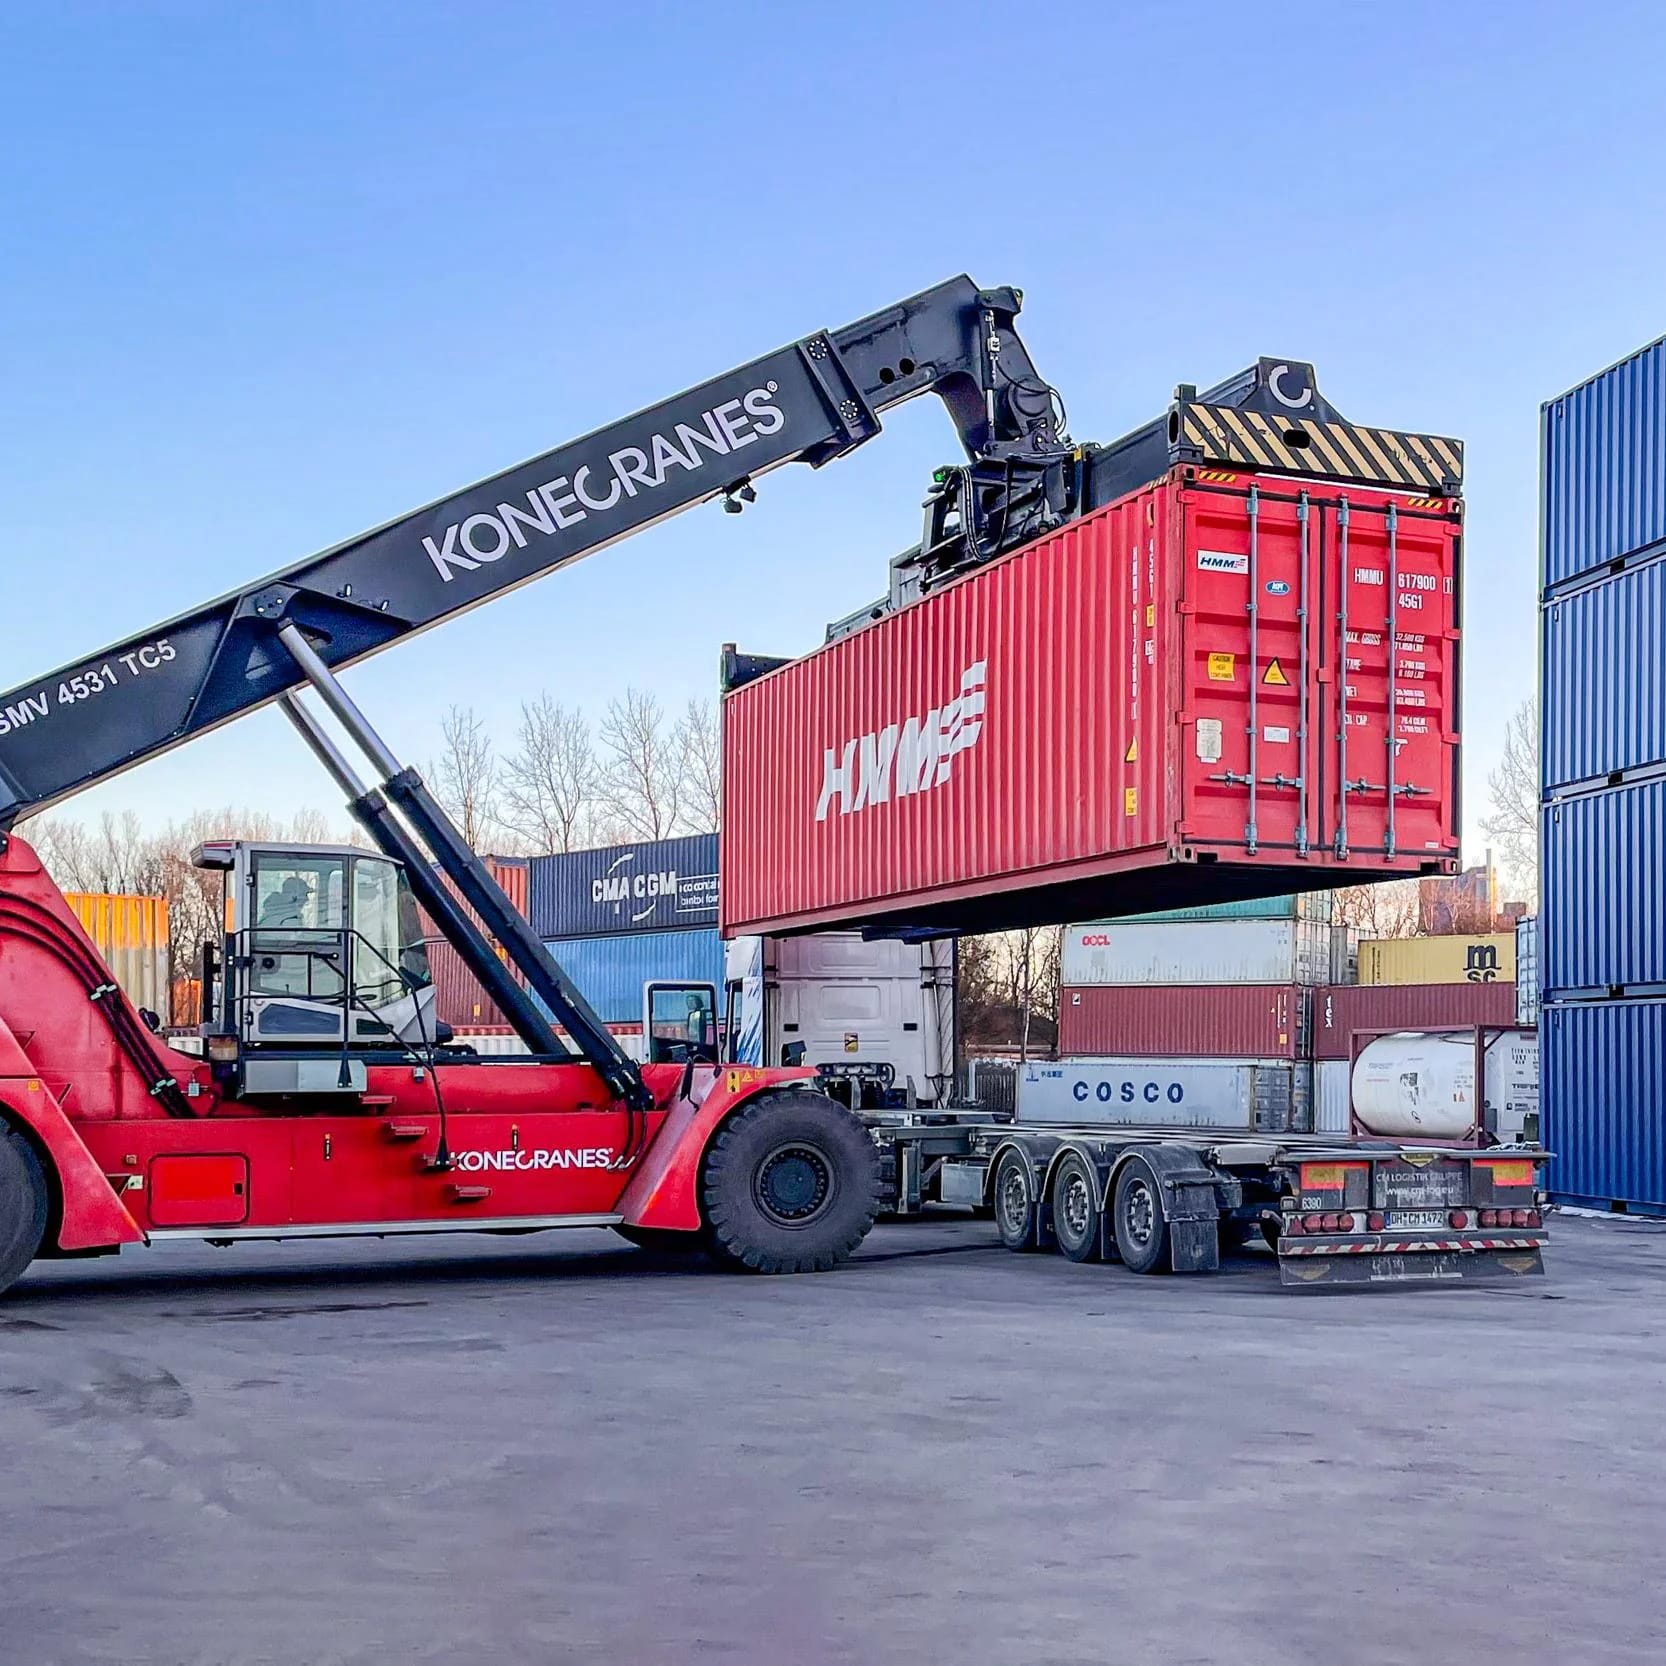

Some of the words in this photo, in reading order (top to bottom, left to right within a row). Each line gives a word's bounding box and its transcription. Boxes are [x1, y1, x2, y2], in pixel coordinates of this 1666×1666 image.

[1354, 568, 1384, 586] HMMU
[1398, 573, 1436, 591] 617900
[1398, 593, 1423, 610] 45G1
[0, 692, 49, 735] SMV
[57, 663, 119, 705] 4531
[118, 639, 176, 676] TC5
[592, 877, 630, 902] CMA
[634, 871, 676, 898] CGM
[1073, 1081, 1184, 1103] COSCO
